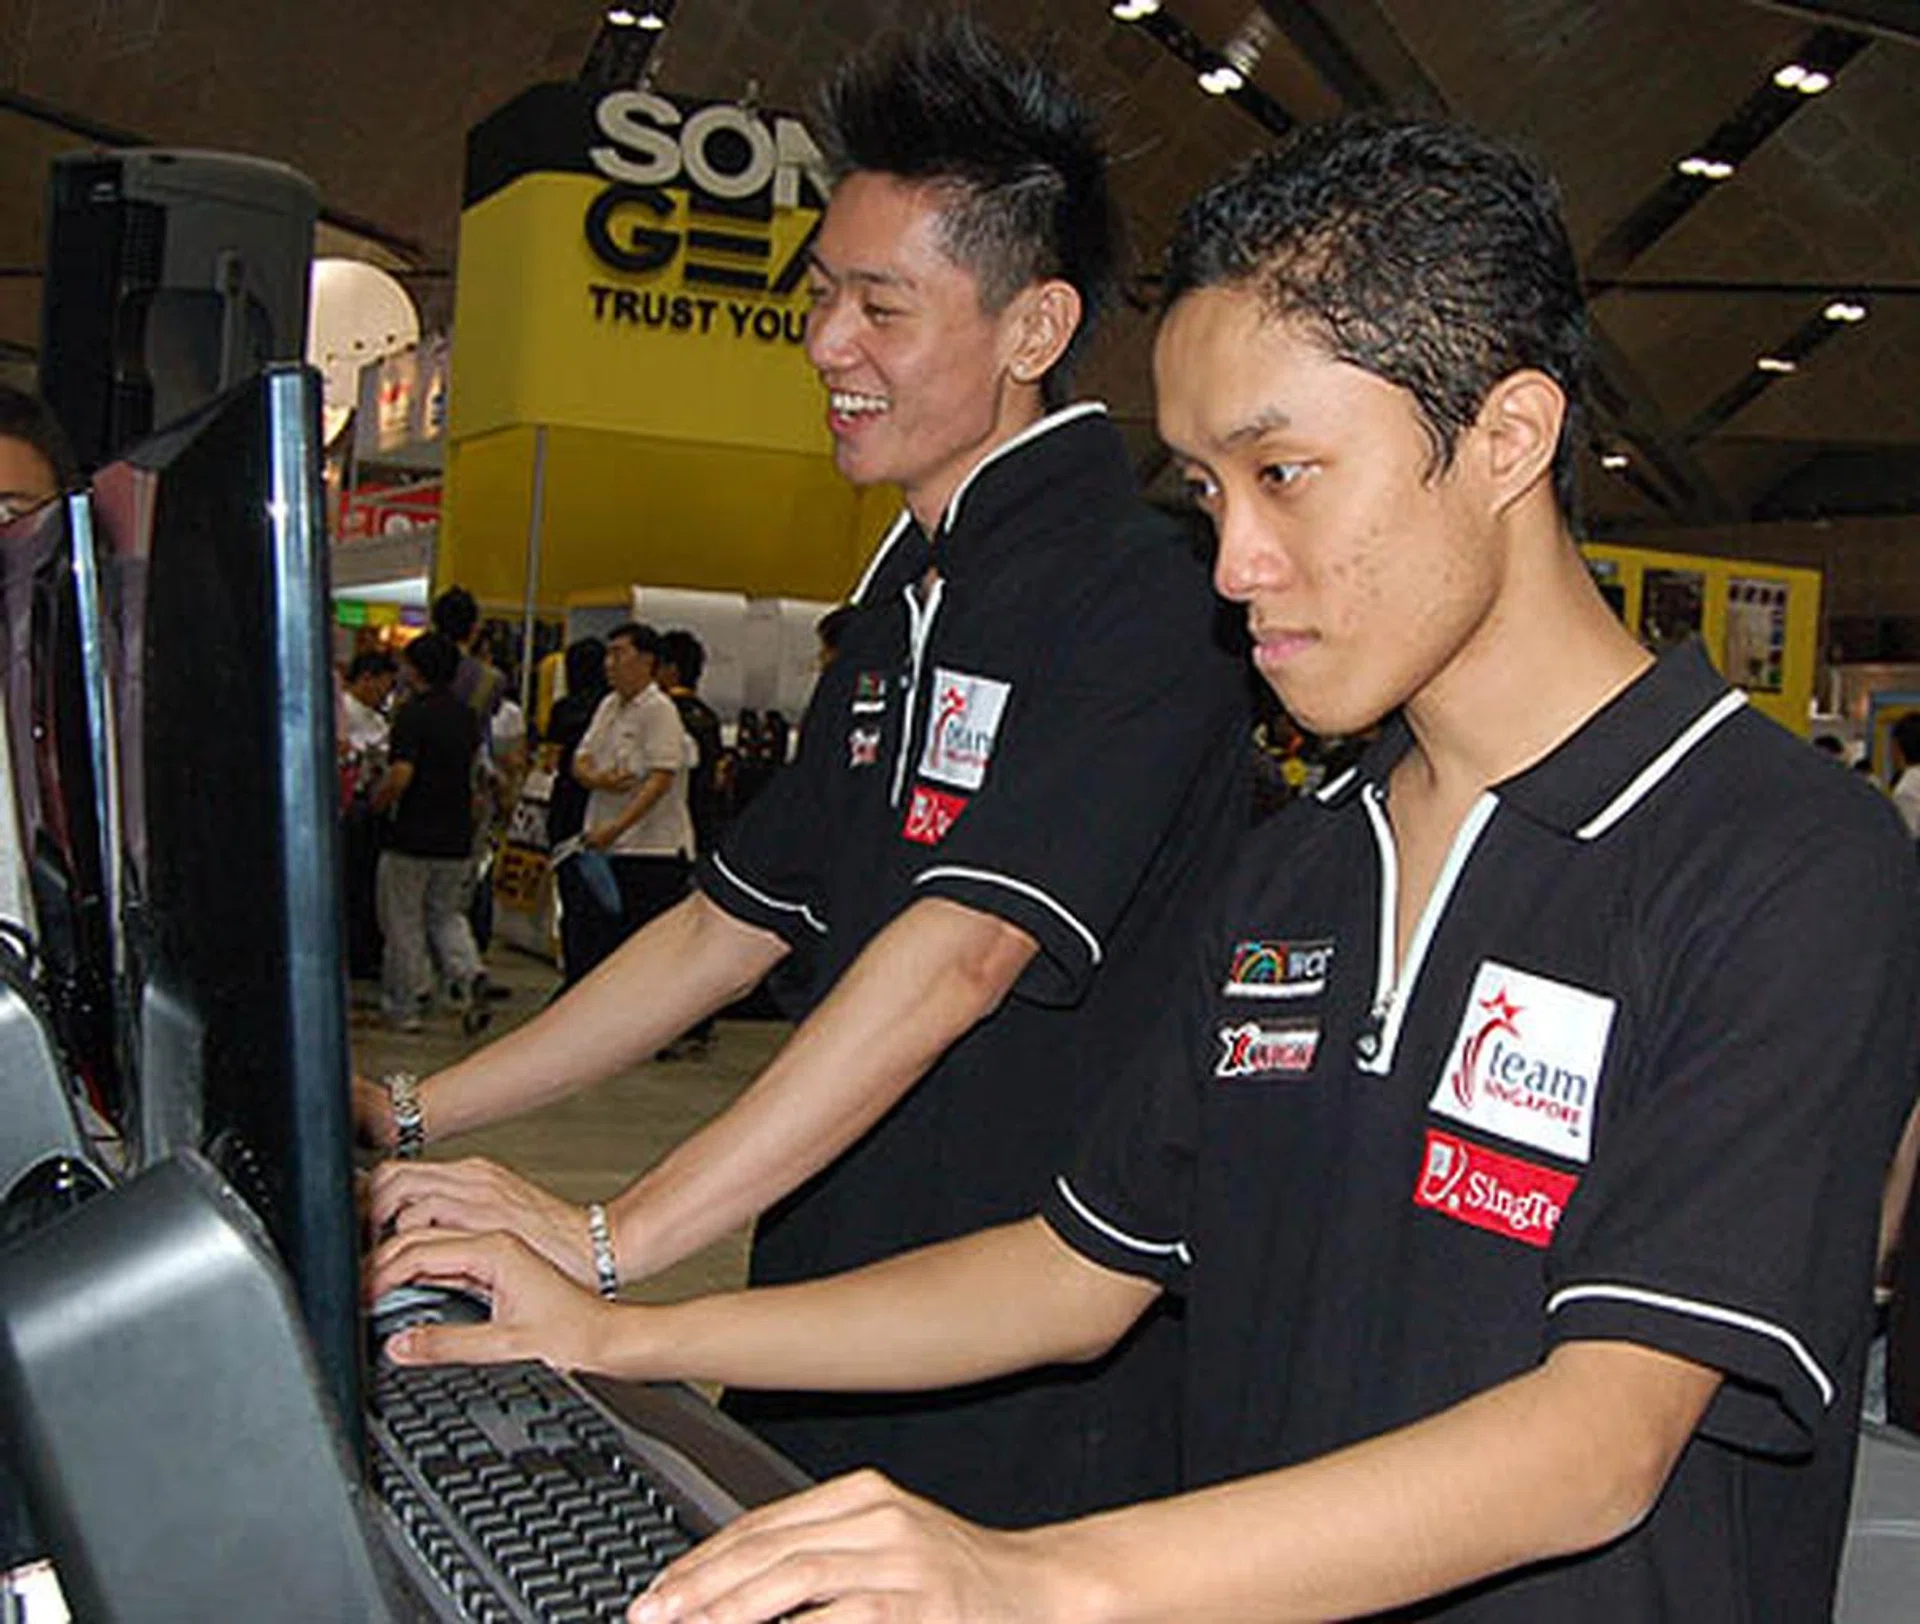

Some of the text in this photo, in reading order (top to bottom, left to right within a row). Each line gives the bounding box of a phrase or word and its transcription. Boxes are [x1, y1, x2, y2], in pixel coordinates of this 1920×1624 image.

[589, 285, 807, 344] TRUST YOU
[1489, 1040, 1588, 1107] team
